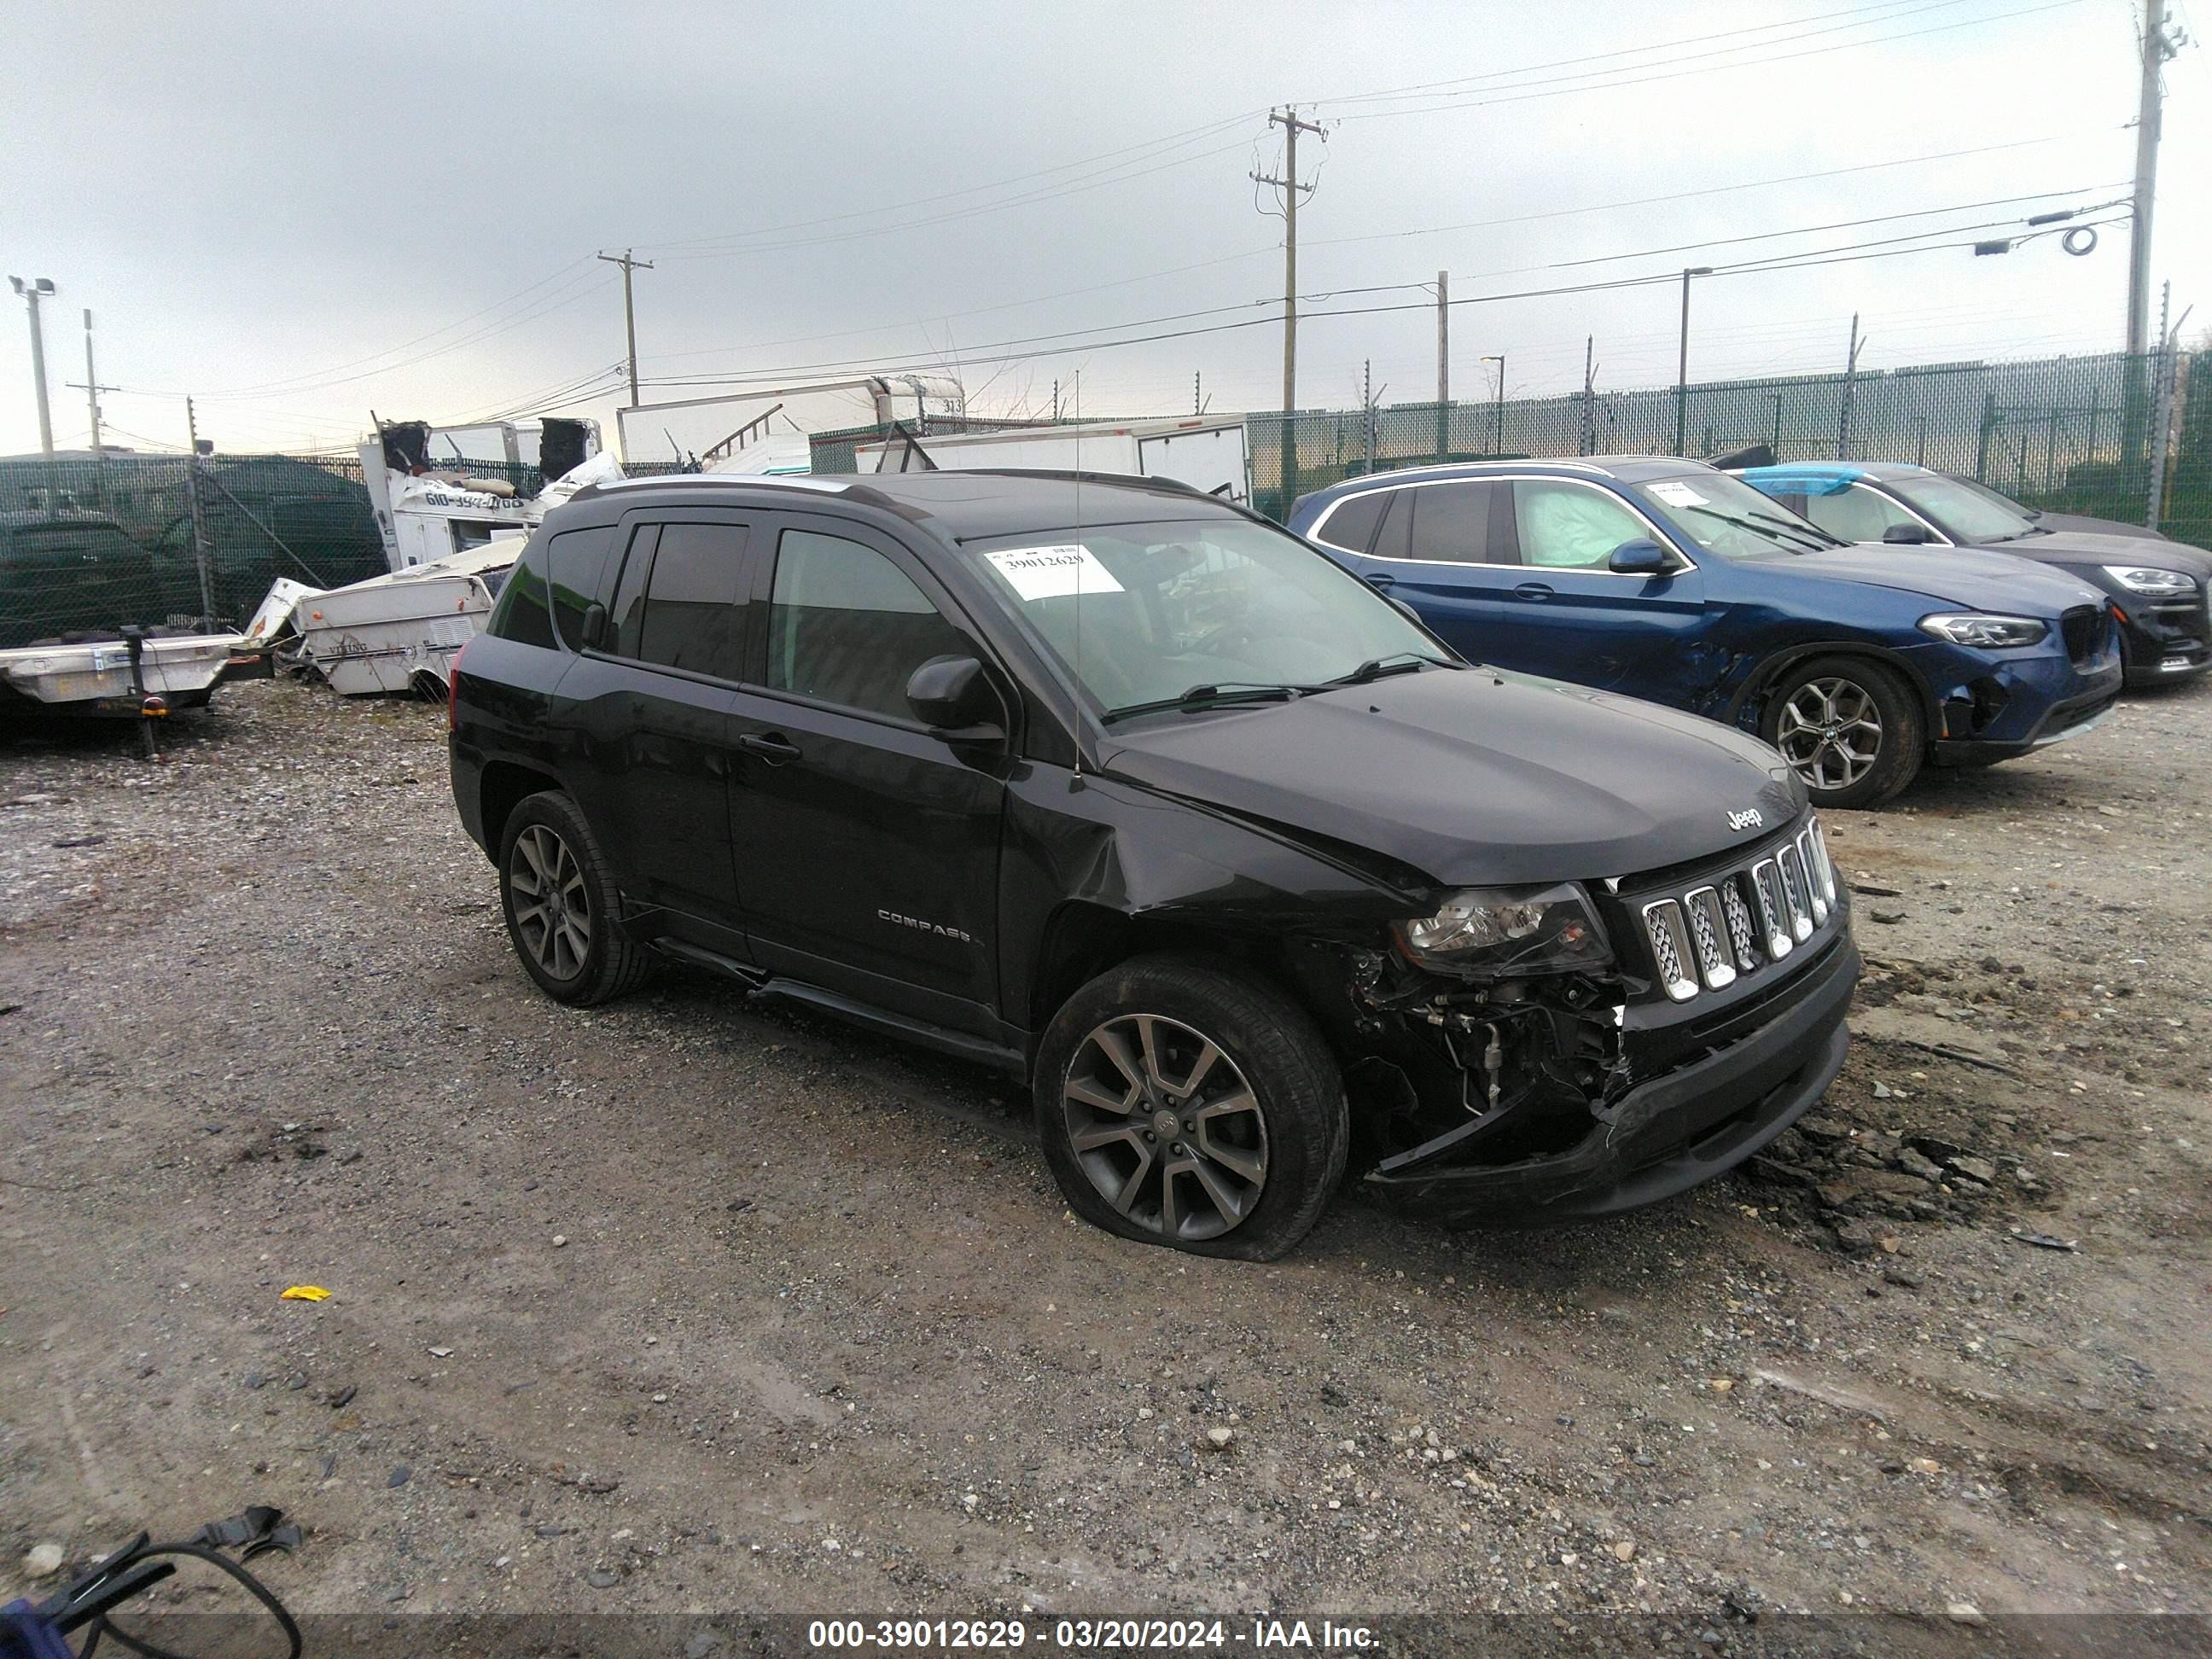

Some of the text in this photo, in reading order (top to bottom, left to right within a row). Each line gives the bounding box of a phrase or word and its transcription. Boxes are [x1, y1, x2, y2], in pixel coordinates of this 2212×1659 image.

[943, 399, 961, 413] 313
[1005, 556, 1085, 570] 39012629
[1726, 808, 1763, 831] Jeep
[877, 909, 970, 943] COMPASS
